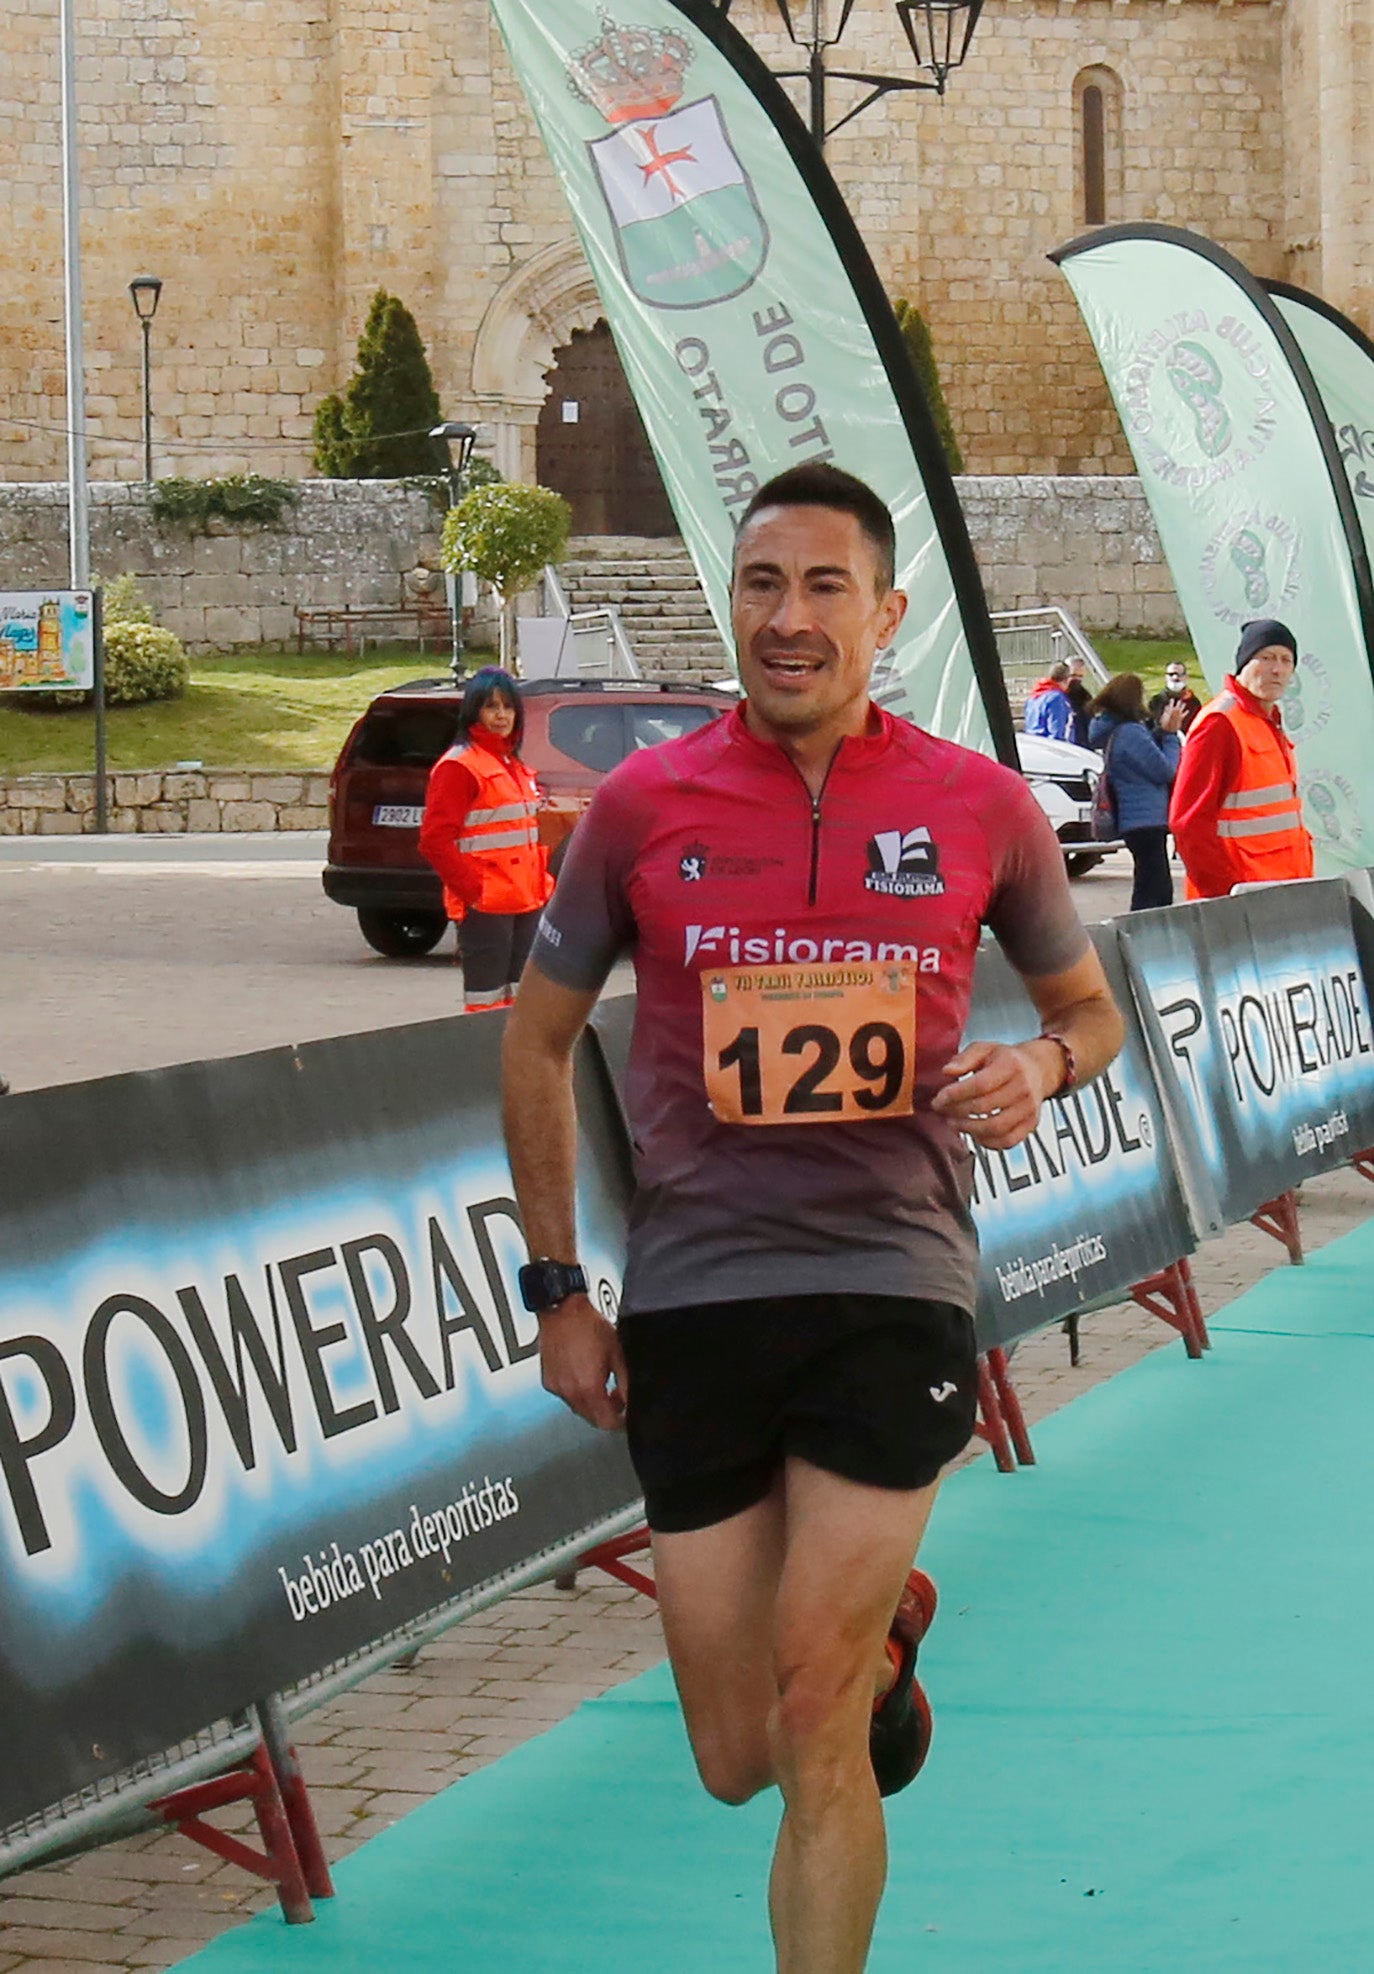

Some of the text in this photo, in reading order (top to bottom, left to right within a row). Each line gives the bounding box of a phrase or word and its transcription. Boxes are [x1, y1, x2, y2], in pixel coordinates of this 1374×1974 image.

[864, 876, 945, 897] FISIORAMA
[683, 924, 941, 974] Fisiorama
[718, 1021, 906, 1117] 129
[1220, 972, 1370, 1102] POWERADE
[0, 1196, 541, 1557] POWERAD
[277, 1475, 520, 1622] bebida para deportistas
